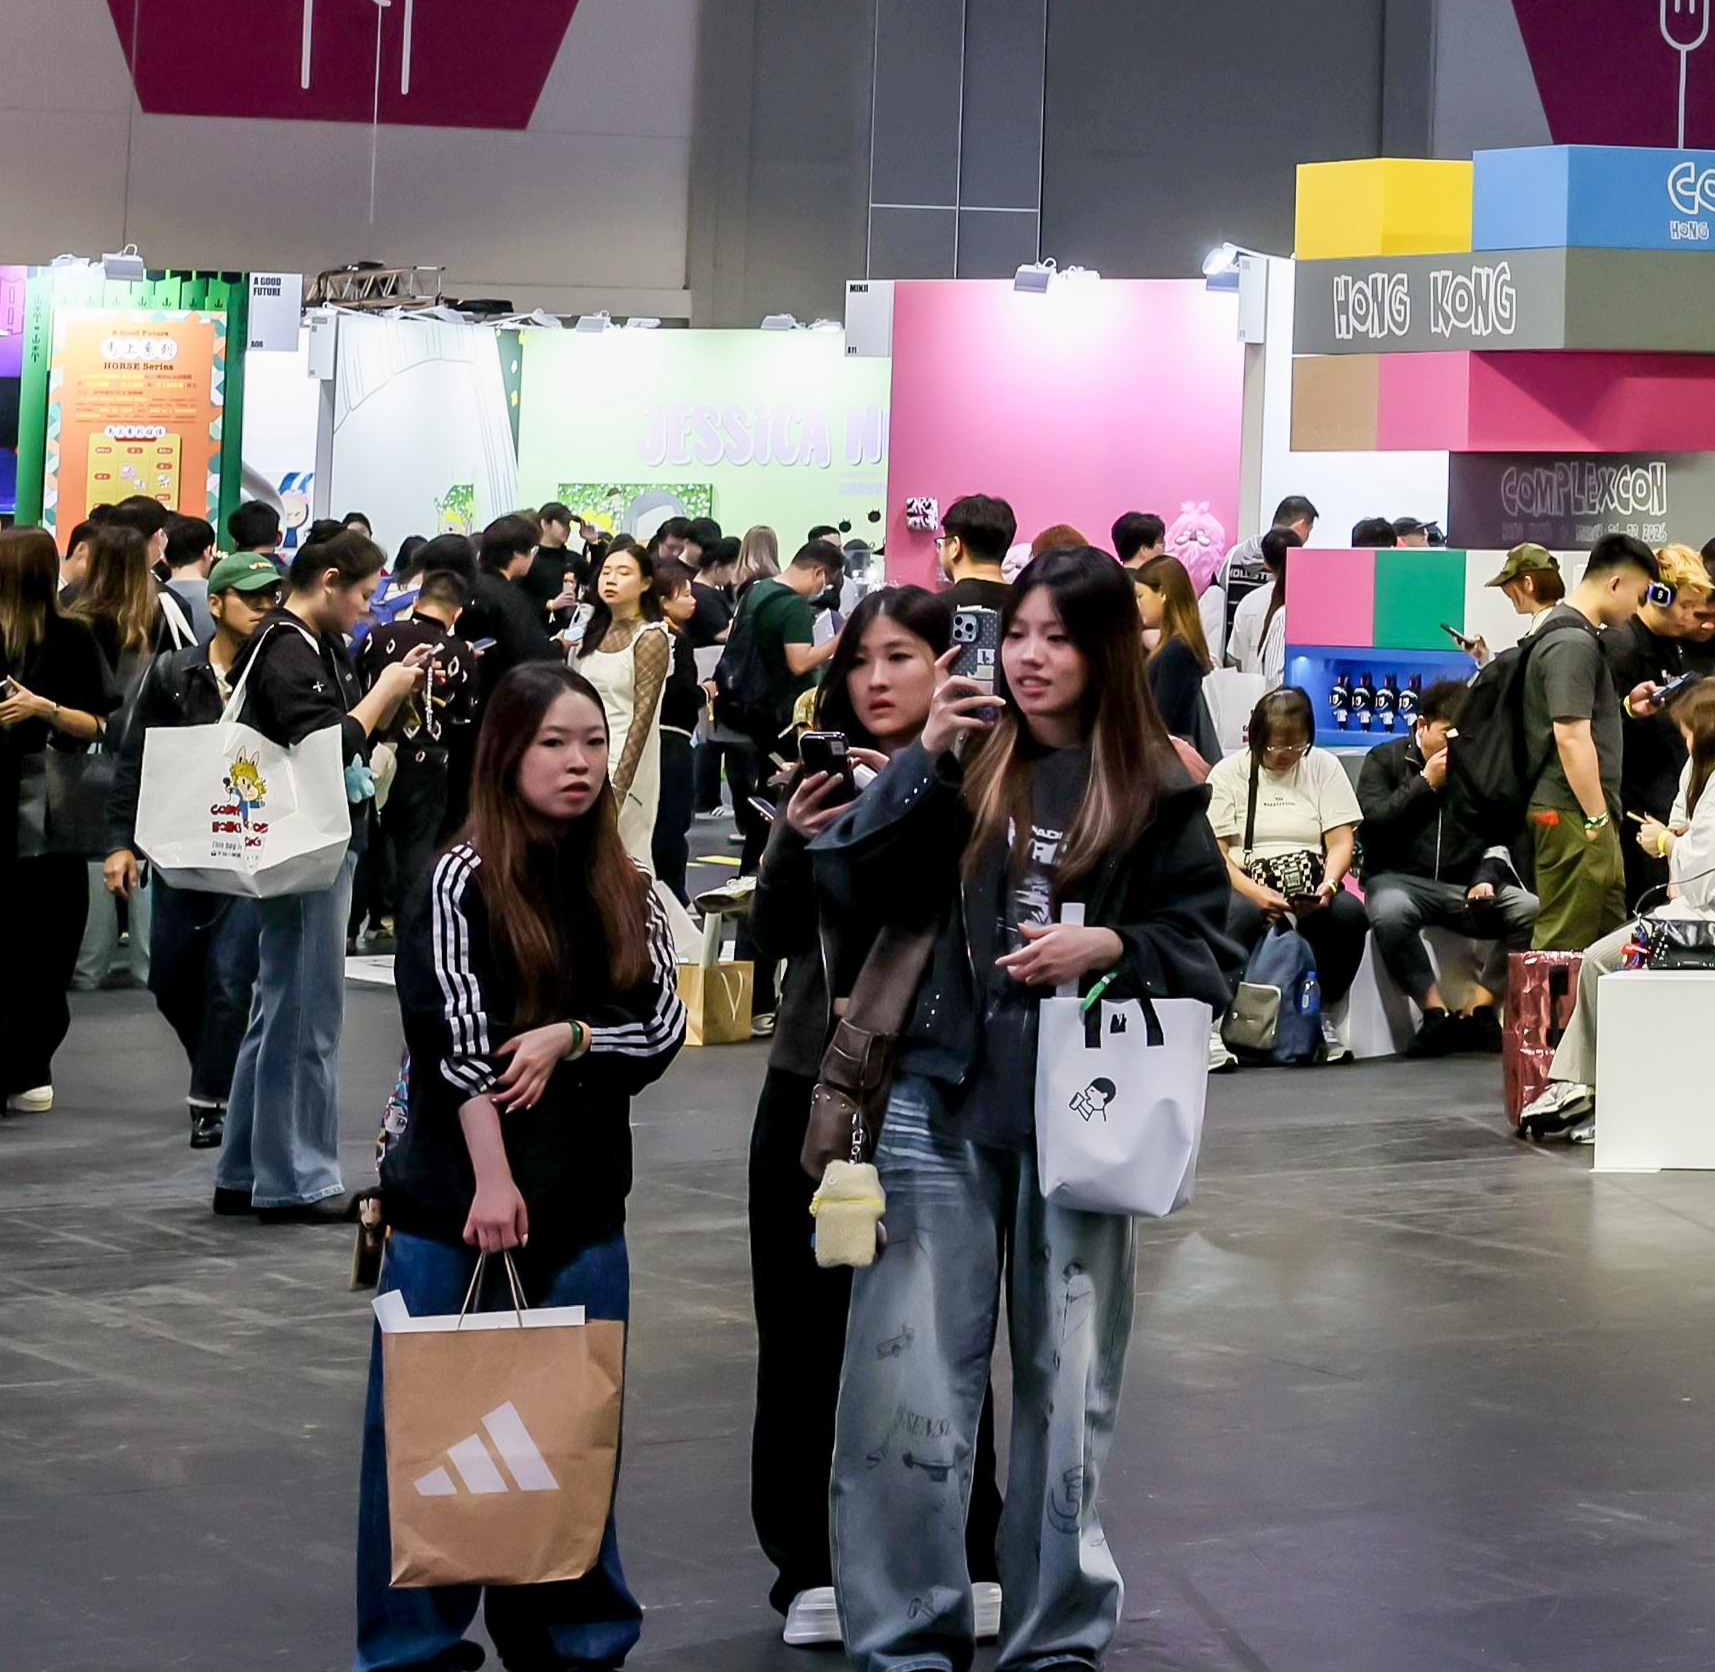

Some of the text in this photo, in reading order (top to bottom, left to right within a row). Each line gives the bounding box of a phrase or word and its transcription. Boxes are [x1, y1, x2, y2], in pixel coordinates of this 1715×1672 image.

[1670, 220, 1709, 240] HONG
[253, 277, 281, 286] A GOOD
[253, 287, 281, 296] FUTURE
[1333, 261, 1516, 340] HONG KONG
[104, 362, 174, 371] HORSE Series
[845, 404, 888, 465] N
[1501, 461, 1668, 518] COMPLEXCON
